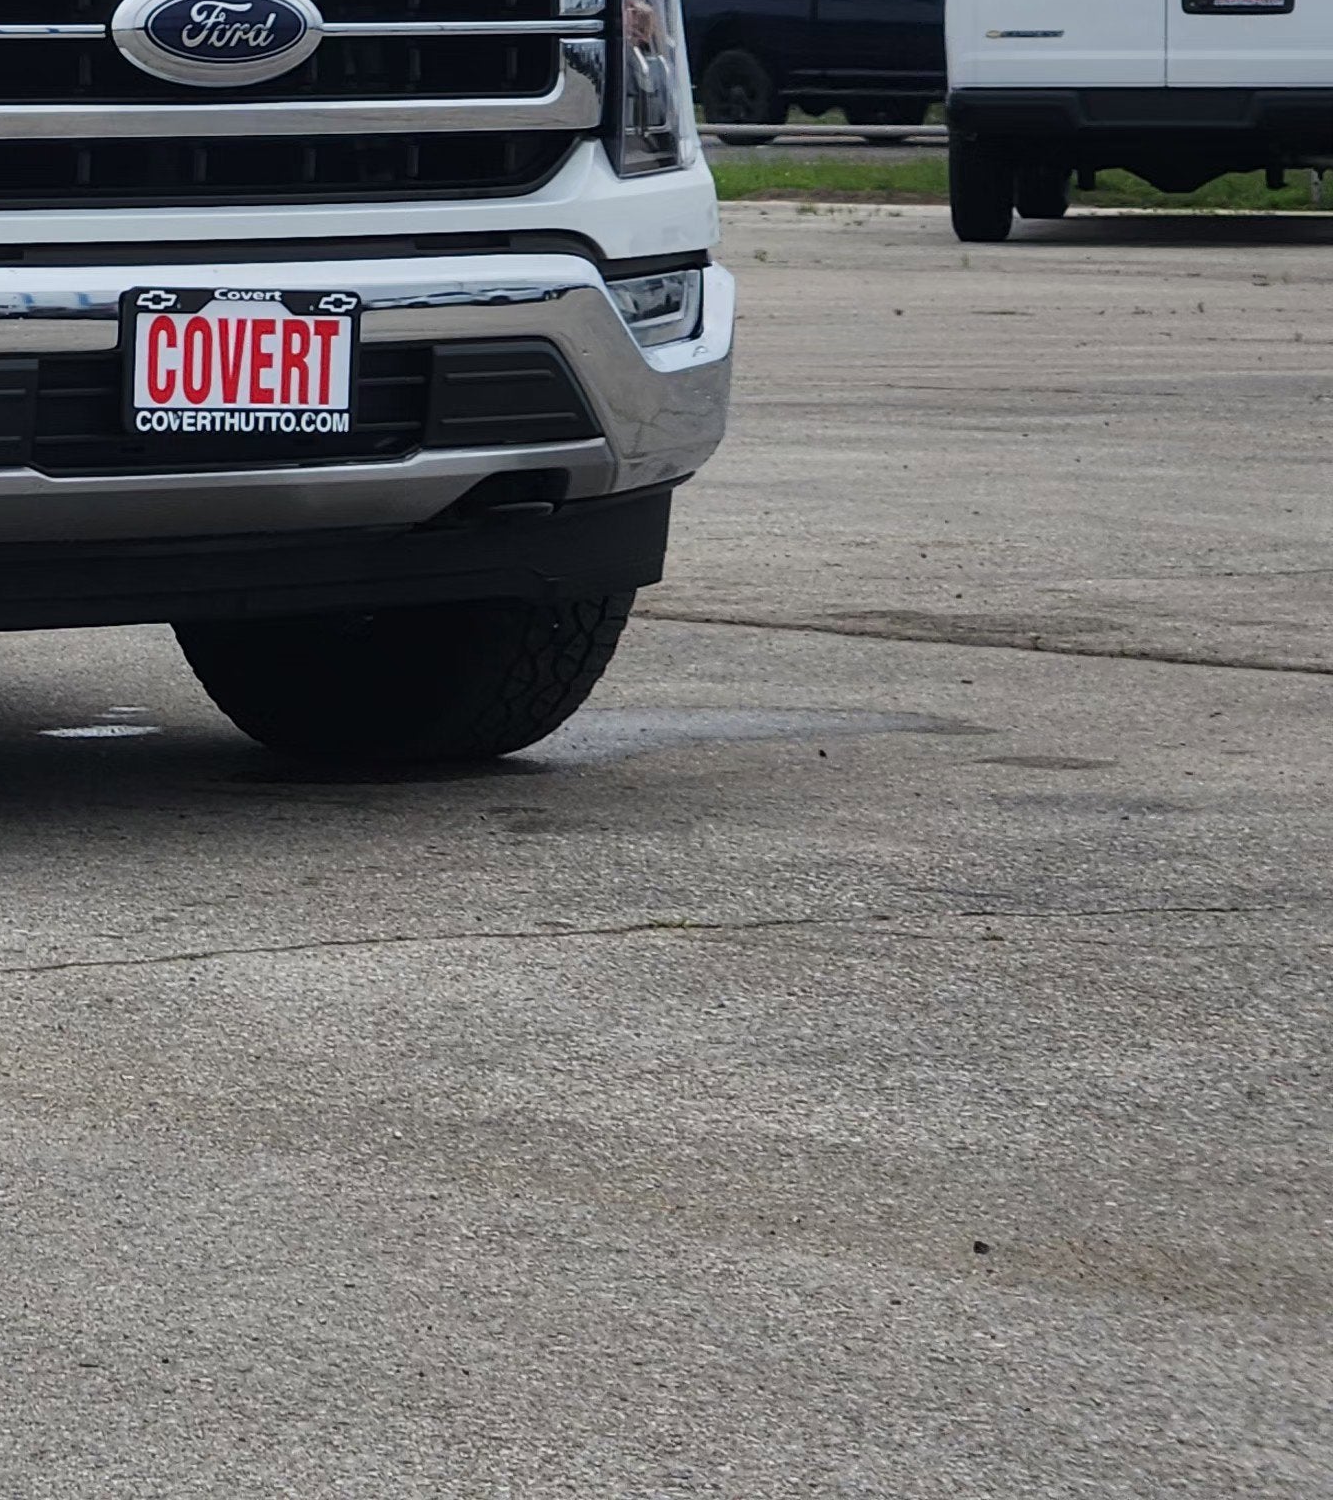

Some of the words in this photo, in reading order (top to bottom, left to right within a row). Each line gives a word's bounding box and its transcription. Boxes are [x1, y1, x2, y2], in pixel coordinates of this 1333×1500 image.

[181, 0, 277, 48] Ford
[213, 288, 282, 301] Covert
[147, 315, 340, 405] COVERT
[136, 410, 349, 433] COVERTHUTTO.COM
